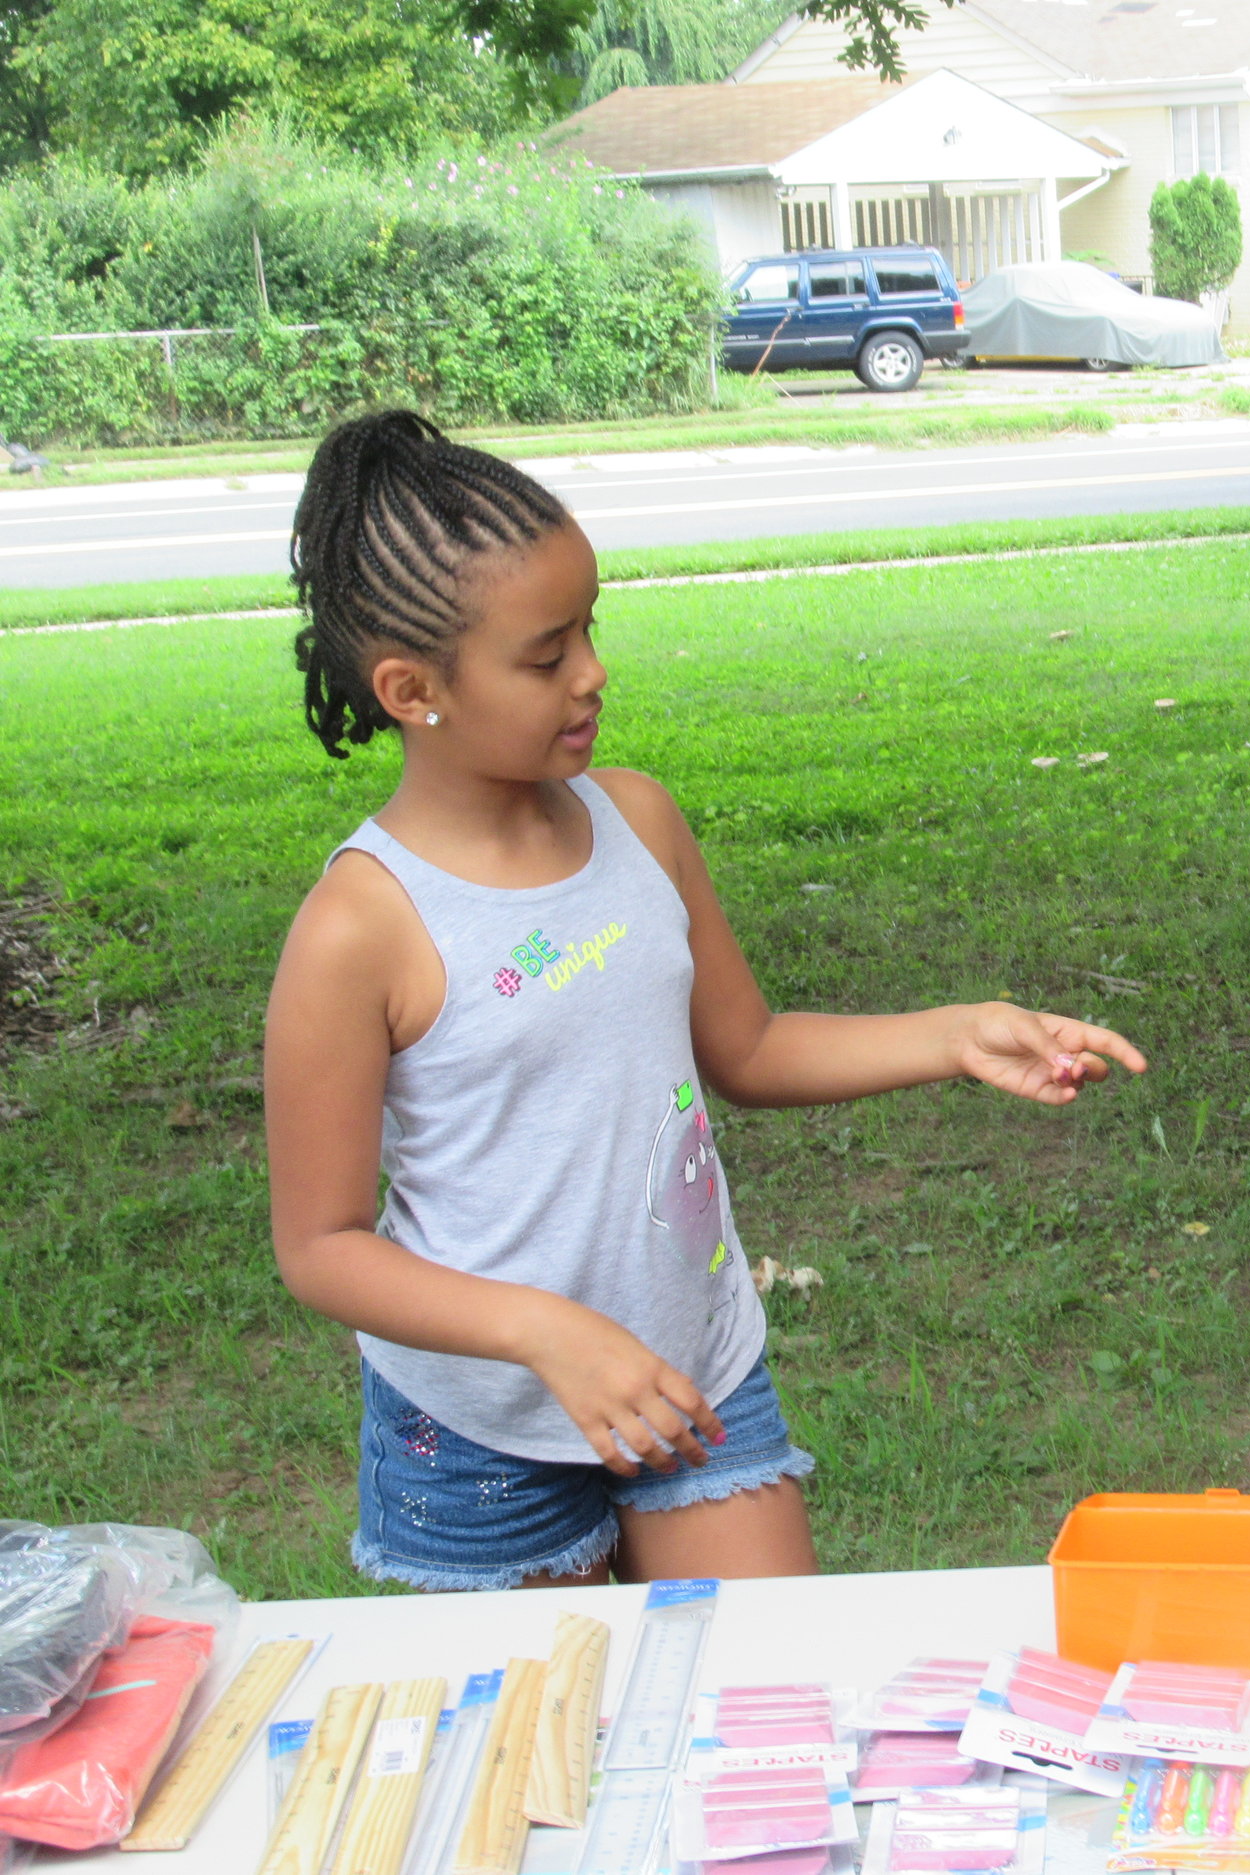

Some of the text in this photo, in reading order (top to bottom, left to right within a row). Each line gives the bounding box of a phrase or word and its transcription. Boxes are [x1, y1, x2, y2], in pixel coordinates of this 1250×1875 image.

[544, 921, 627, 992] unique
[998, 1728, 1122, 1772] STAPLES
[1123, 1731, 1249, 1753] STAPLES
[721, 1752, 848, 1767] STAPLES
